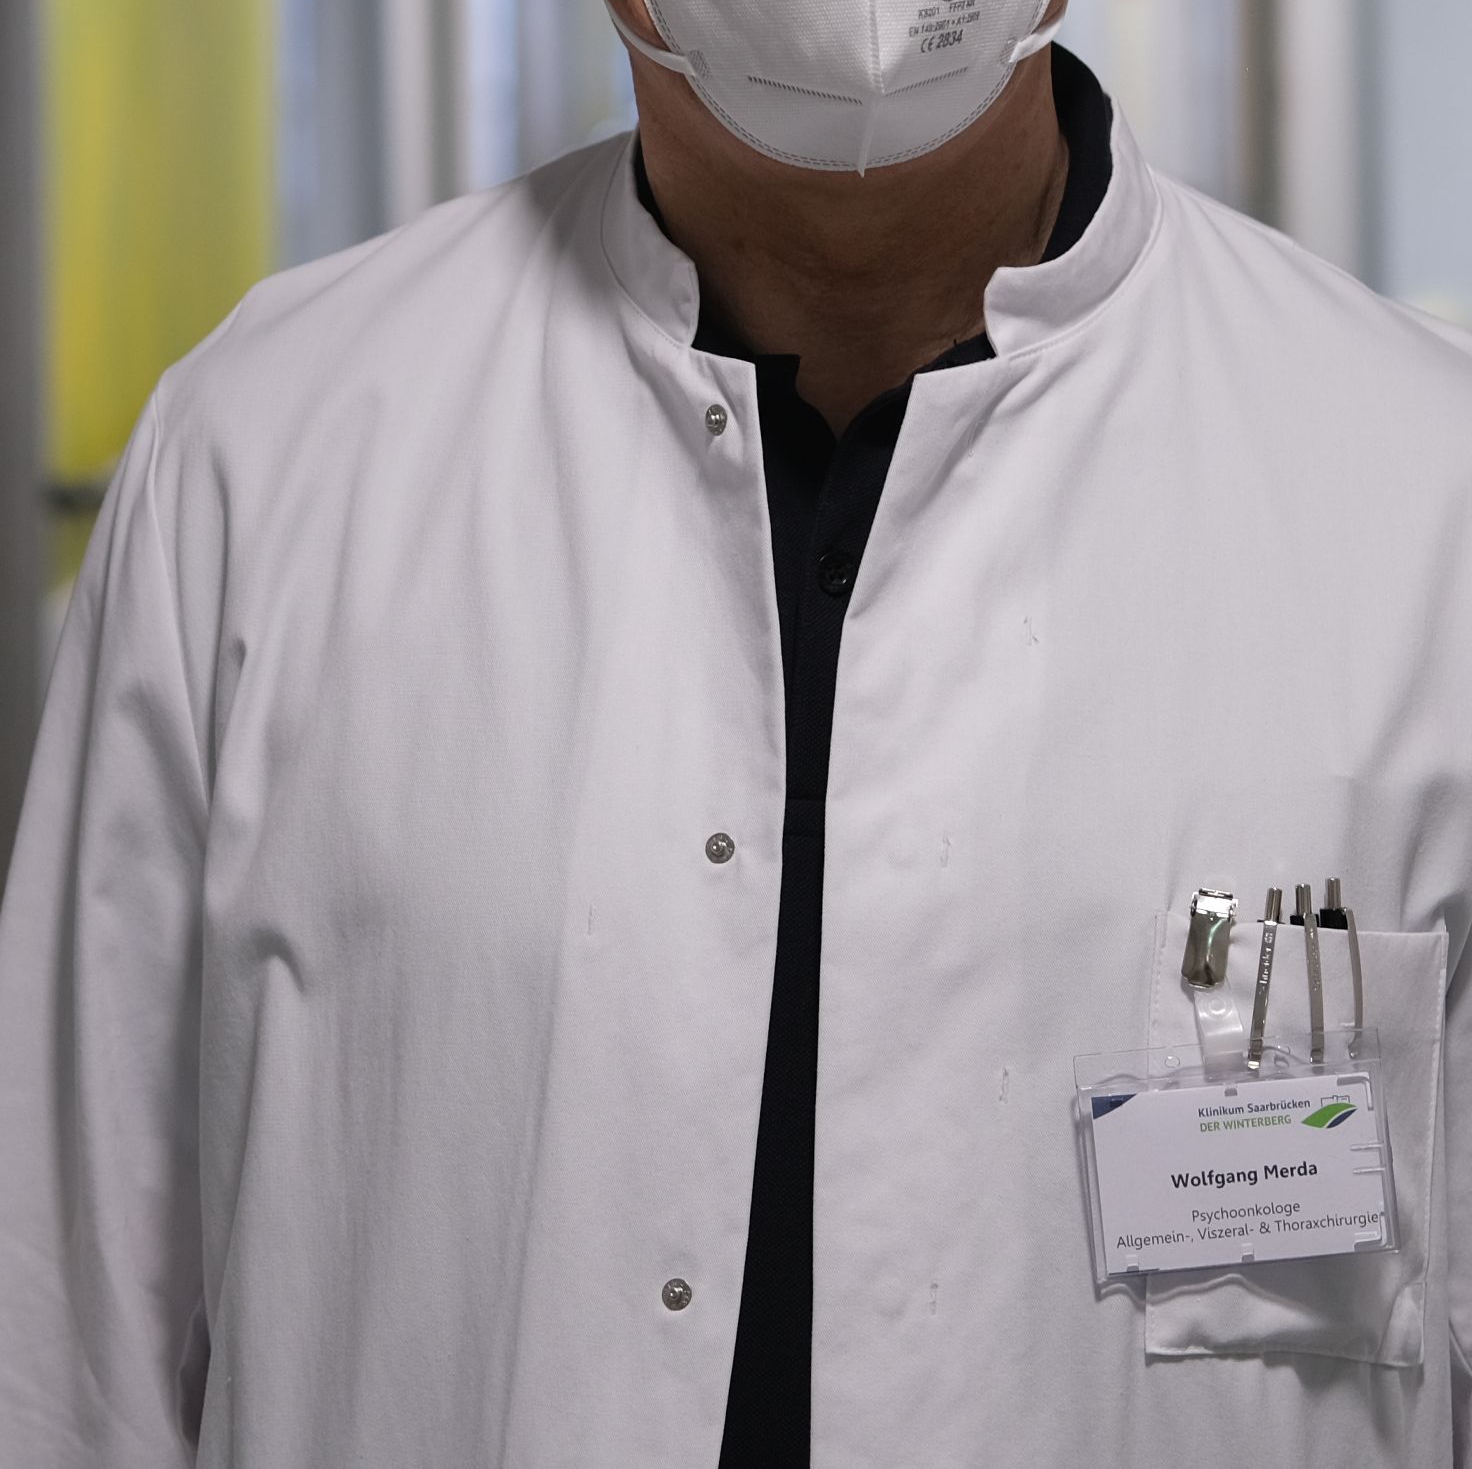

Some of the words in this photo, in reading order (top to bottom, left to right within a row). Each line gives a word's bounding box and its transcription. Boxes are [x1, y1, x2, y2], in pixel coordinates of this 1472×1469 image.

[1197, 1105, 1245, 1118] Klinikum
[1247, 1098, 1311, 1114] Saarbrücken
[1199, 1120, 1221, 1133] DER
[1222, 1114, 1292, 1130] WINTERBERG
[1170, 1169, 1259, 1190] Wolfgang
[1263, 1161, 1318, 1181] Merda
[1191, 1201, 1301, 1226] Psychoonkologe
[1116, 1230, 1194, 1251] Allgemein-,
[1197, 1221, 1254, 1241] Viszeral-
[1258, 1221, 1271, 1235] &
[1274, 1212, 1379, 1234] Thoraxchirurgie
